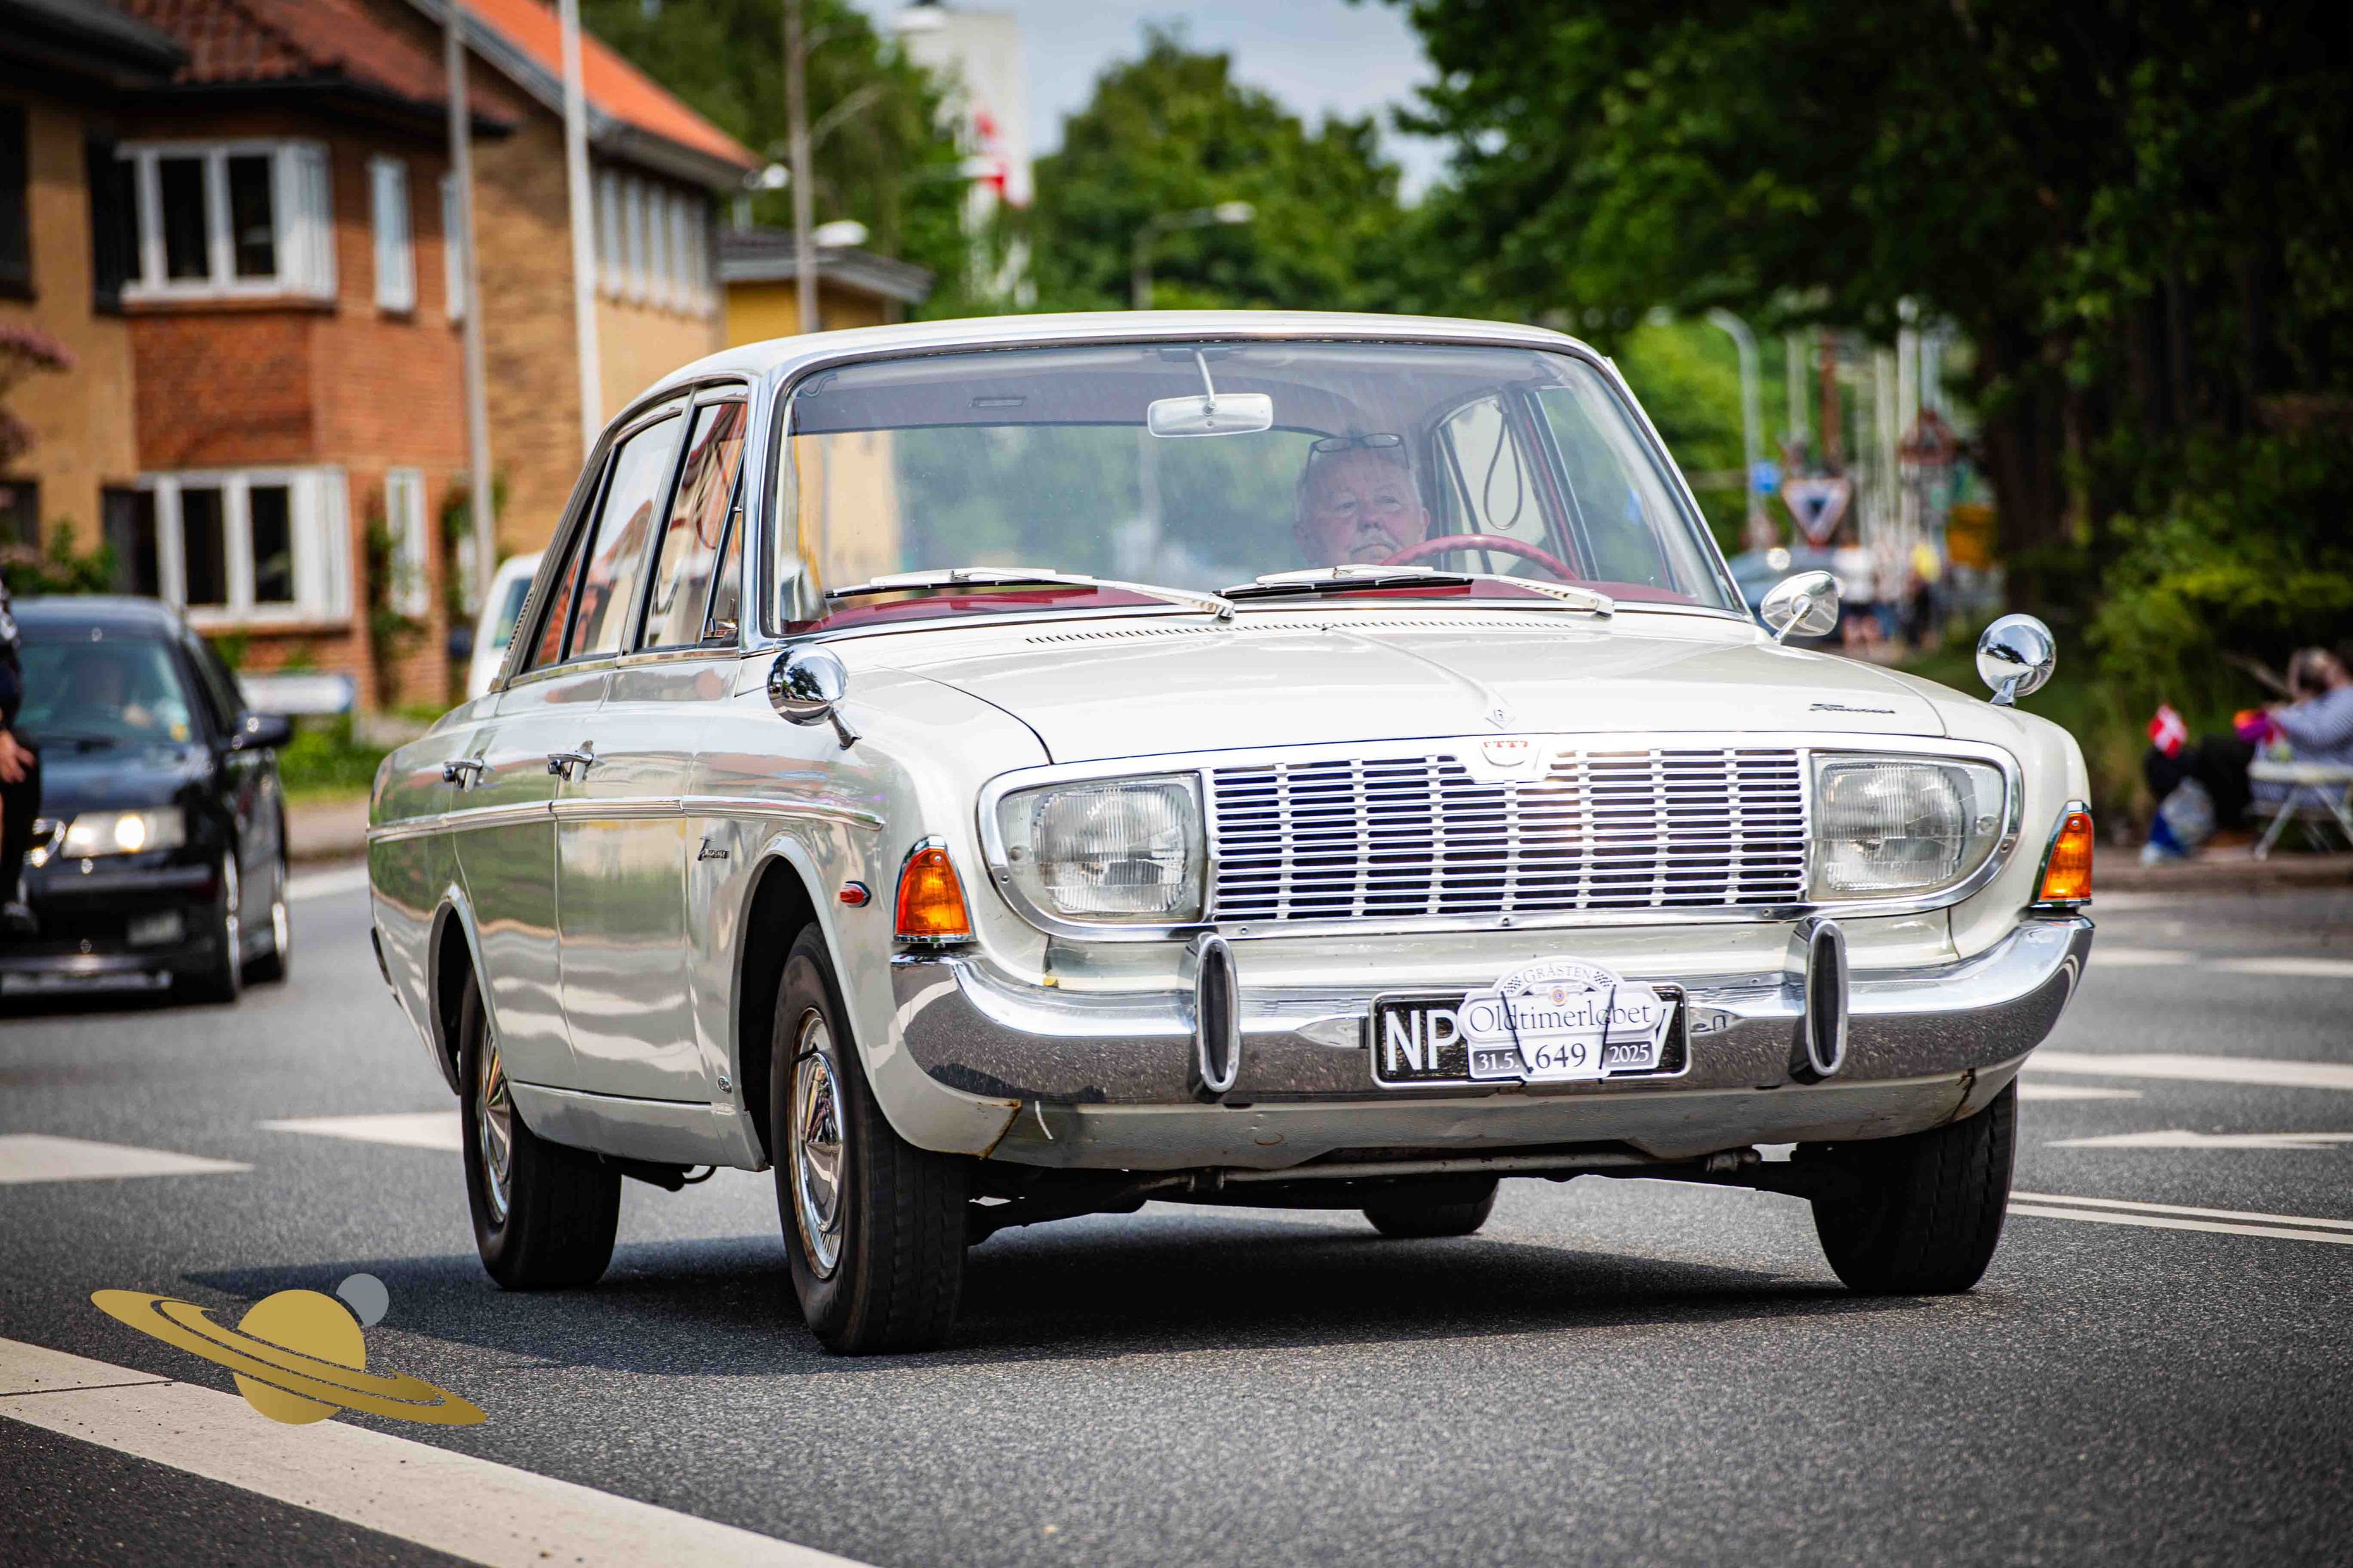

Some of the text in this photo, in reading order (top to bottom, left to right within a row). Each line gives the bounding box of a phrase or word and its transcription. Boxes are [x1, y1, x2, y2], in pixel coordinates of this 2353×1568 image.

[1524, 962, 1591, 983] GRÅSTEN
[1385, 1009, 1460, 1071] NP
[1535, 1042, 1586, 1069] 649
[1609, 1044, 1649, 1063] 2025
